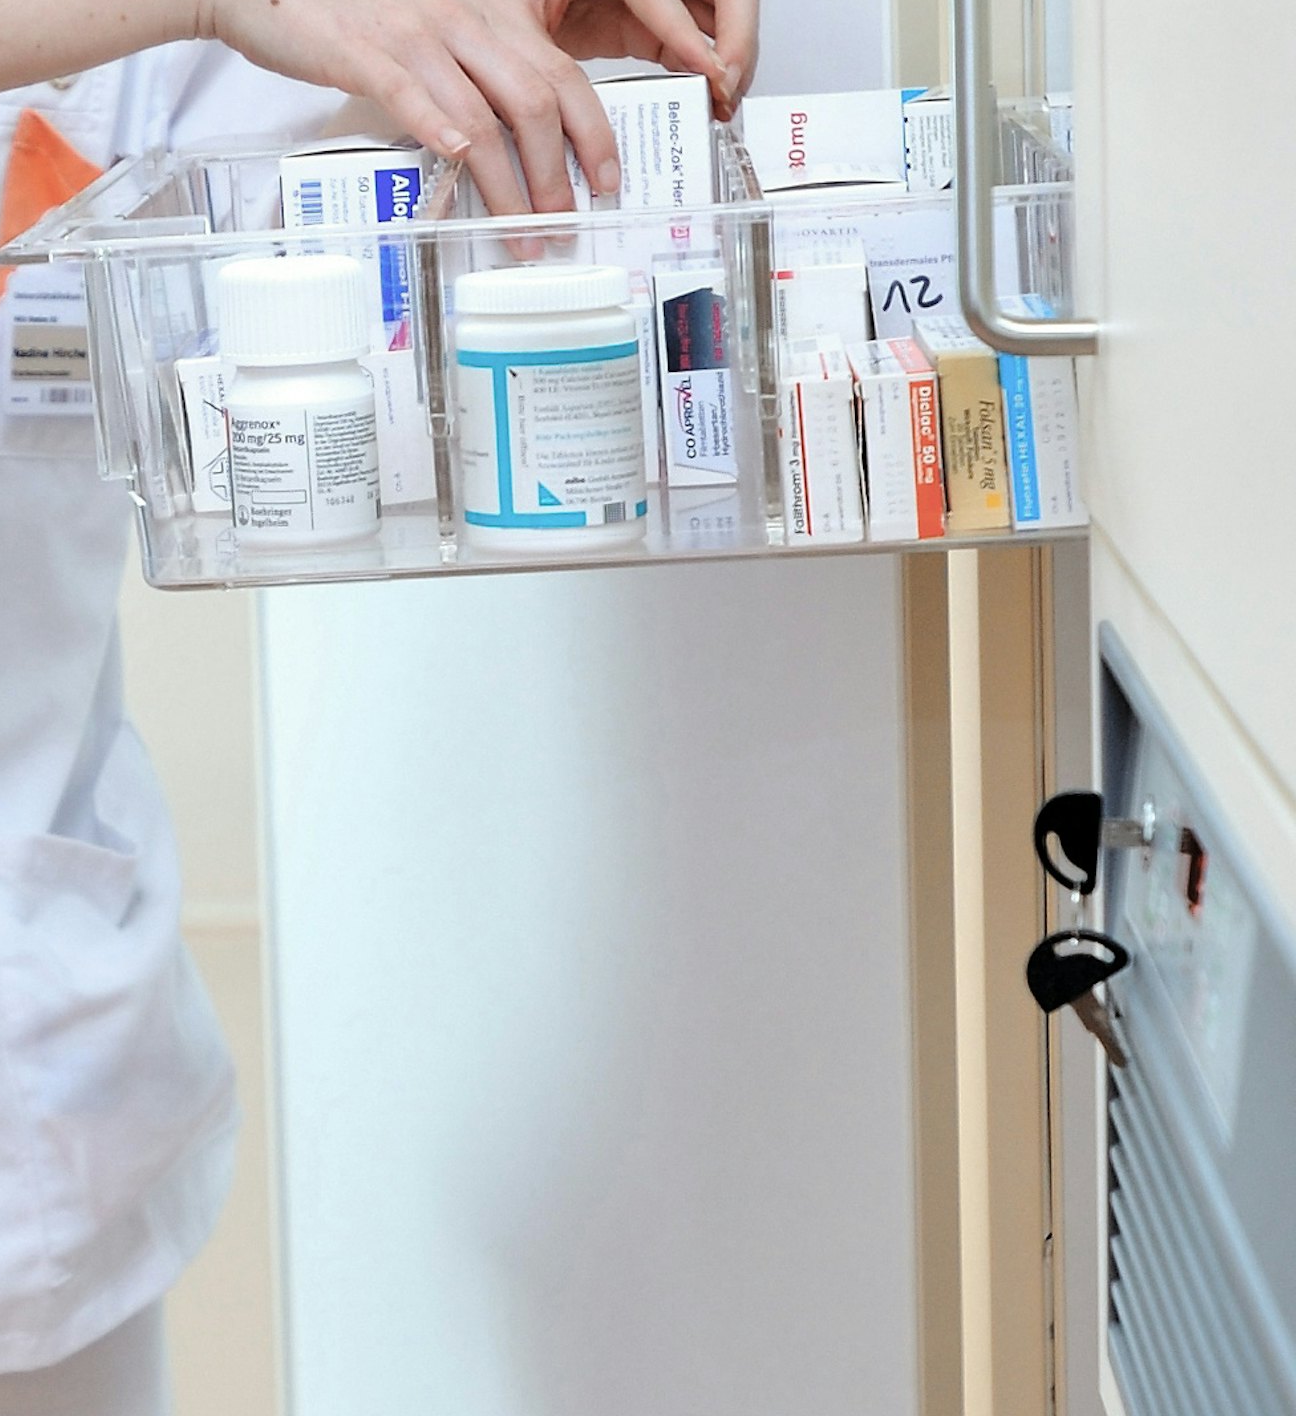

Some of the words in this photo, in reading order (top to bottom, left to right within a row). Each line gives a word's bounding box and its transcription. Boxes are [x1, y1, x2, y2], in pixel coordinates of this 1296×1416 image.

[284, 434, 306, 446] mg
[685, 437, 697, 460] CO
[788, 458, 800, 466] 3
[922, 444, 936, 464] 50
[979, 467, 996, 490] mg
